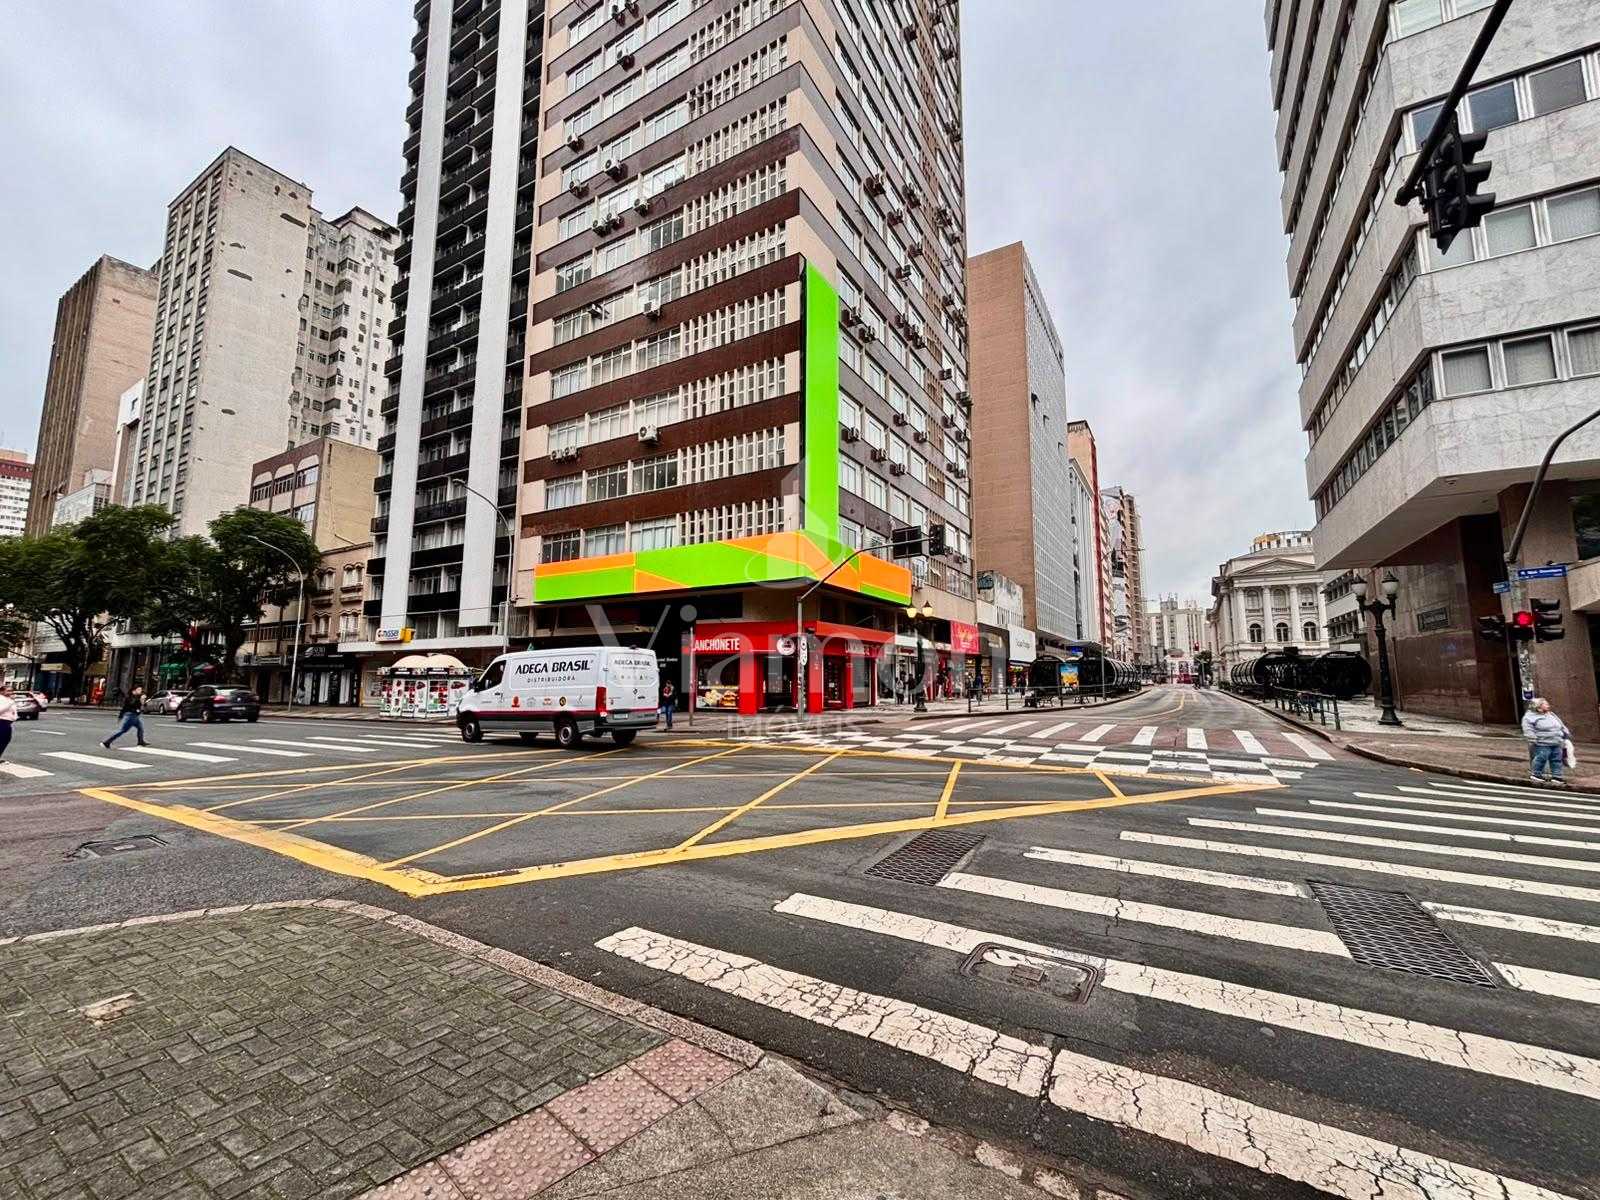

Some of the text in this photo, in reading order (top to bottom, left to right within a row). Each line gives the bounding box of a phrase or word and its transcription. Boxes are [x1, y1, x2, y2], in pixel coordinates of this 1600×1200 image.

[514, 660, 591, 676] ADEGA BRASIL
[527, 675, 576, 684] DISTRIBUIDORA
